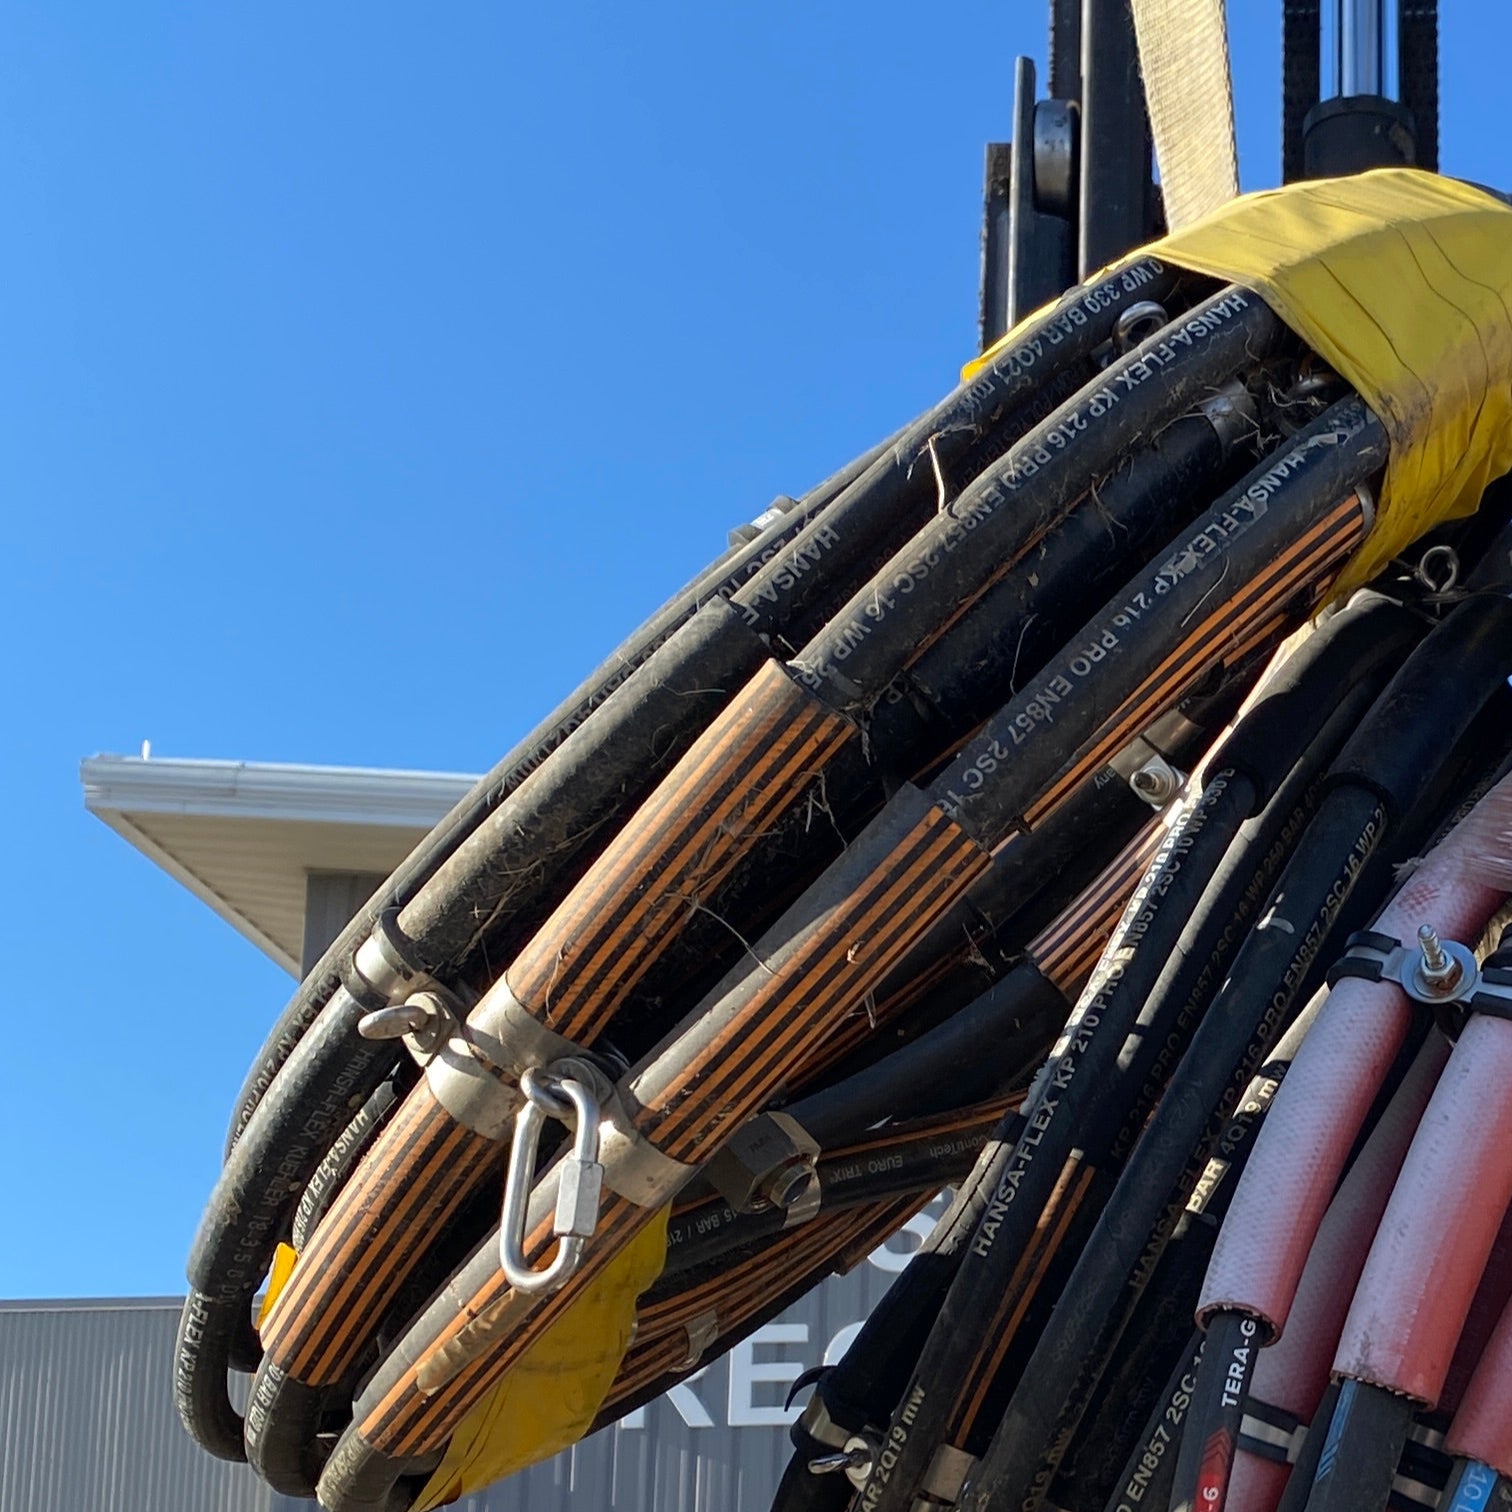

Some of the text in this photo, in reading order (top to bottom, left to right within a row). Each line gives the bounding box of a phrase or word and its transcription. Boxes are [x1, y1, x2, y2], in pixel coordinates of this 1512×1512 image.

[1084, 283, 1122, 315] 330
[1122, 267, 1150, 293] WP
[1050, 306, 1088, 346] BAR
[1114, 293, 1249, 391] HANSA-FLEX
[1089, 387, 1120, 418] KP
[1046, 414, 1088, 449] 216
[1181, 451, 1307, 572] HANSA-FLEX
[893, 551, 940, 594] 2SC
[864, 592, 896, 622] 16
[833, 620, 871, 659] WP
[1069, 627, 1121, 677] PRO
[961, 739, 1011, 790] 2SC
[1256, 990, 1289, 1039] PRO
[1284, 920, 1320, 987] EN857
[1319, 879, 1349, 919] 2SC
[1342, 854, 1362, 878] 16
[1354, 822, 1378, 857] WP
[972, 1097, 1063, 1258] HANSA-FLEX
[1050, 1056, 1077, 1090] KP
[1070, 1011, 1100, 1054] 210
[1151, 861, 1181, 898] 2SC
[1176, 835, 1196, 857] 10
[307, 1108, 369, 1195] HANSA-FLEX
[1219, 1100, 1263, 1157] 4Q19
[866, 1155, 904, 1173] EURO
[695, 1213, 721, 1233] BAR
[874, 1426, 909, 1483] 2Q19
[900, 1382, 927, 1427] mw
[1125, 1423, 1171, 1504] EN857
[1165, 1373, 1199, 1425] 2SC
